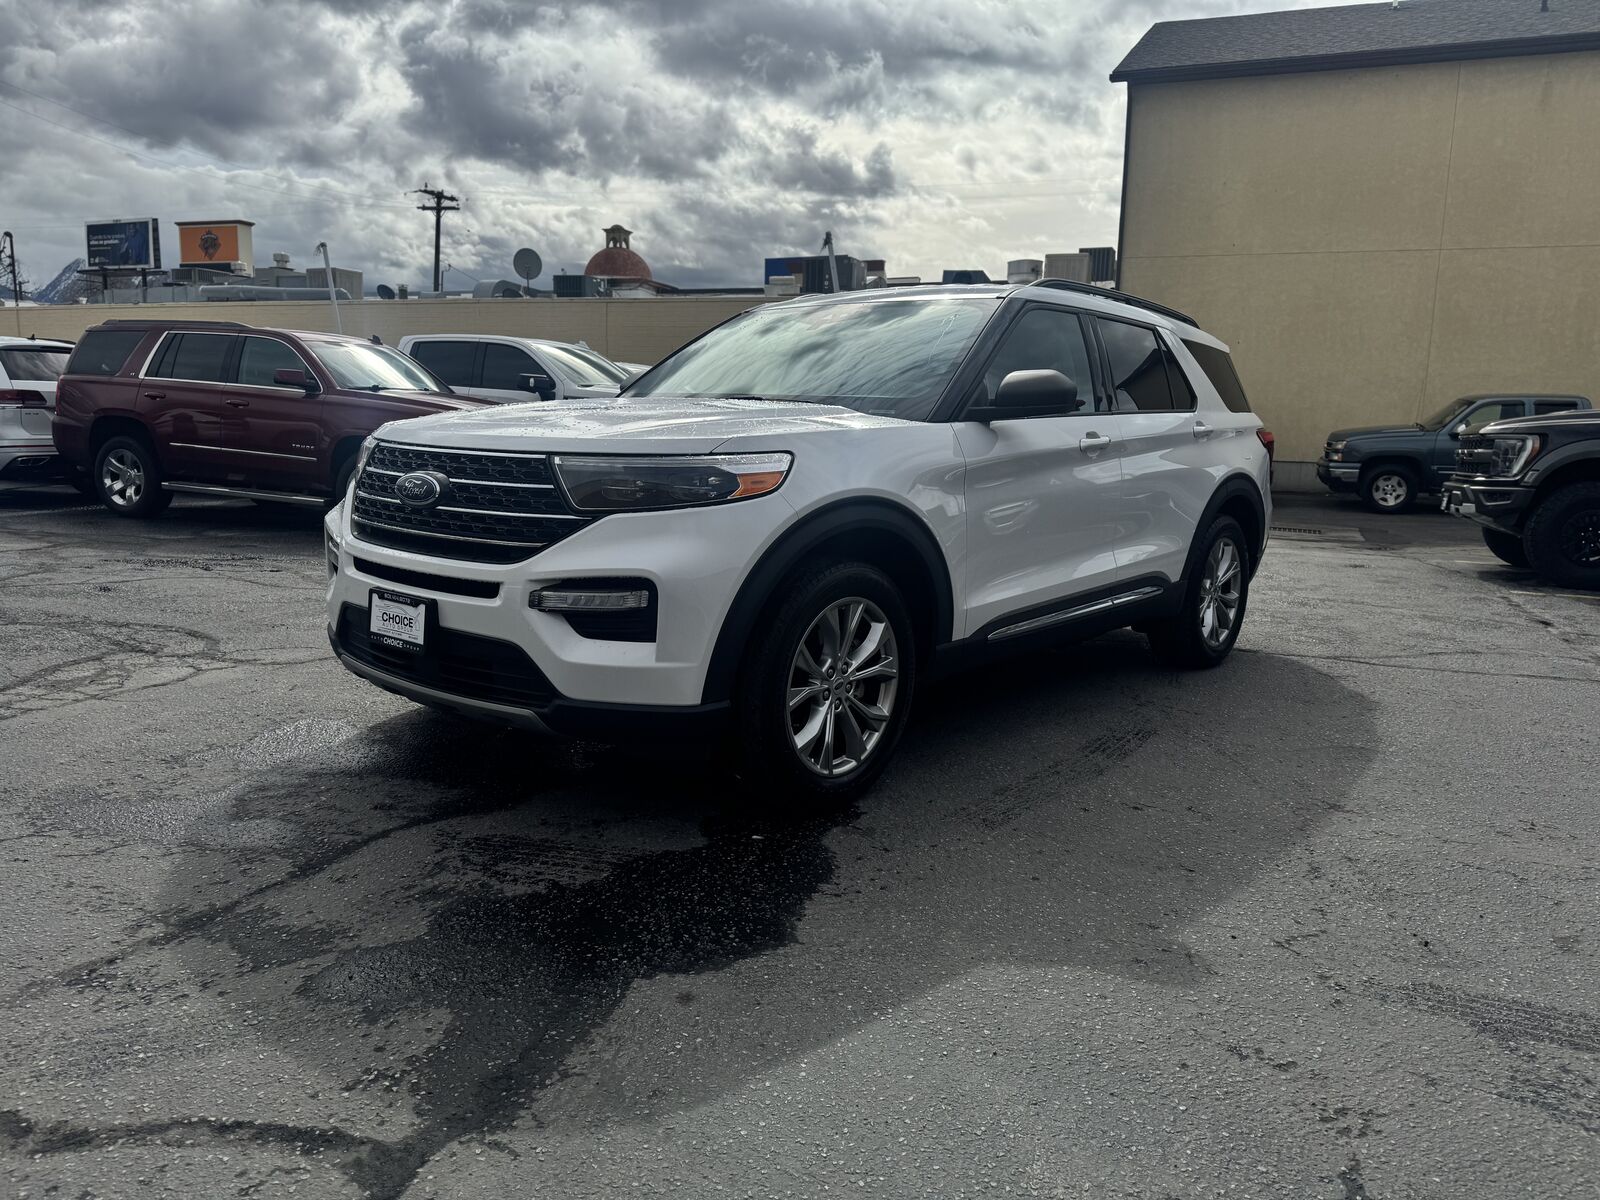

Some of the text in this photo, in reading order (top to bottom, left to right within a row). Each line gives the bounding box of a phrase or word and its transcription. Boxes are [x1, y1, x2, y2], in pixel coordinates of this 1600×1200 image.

[402, 479, 428, 496] Ford
[381, 612, 414, 628] CHOICE
[383, 637, 403, 648] CHOICE
